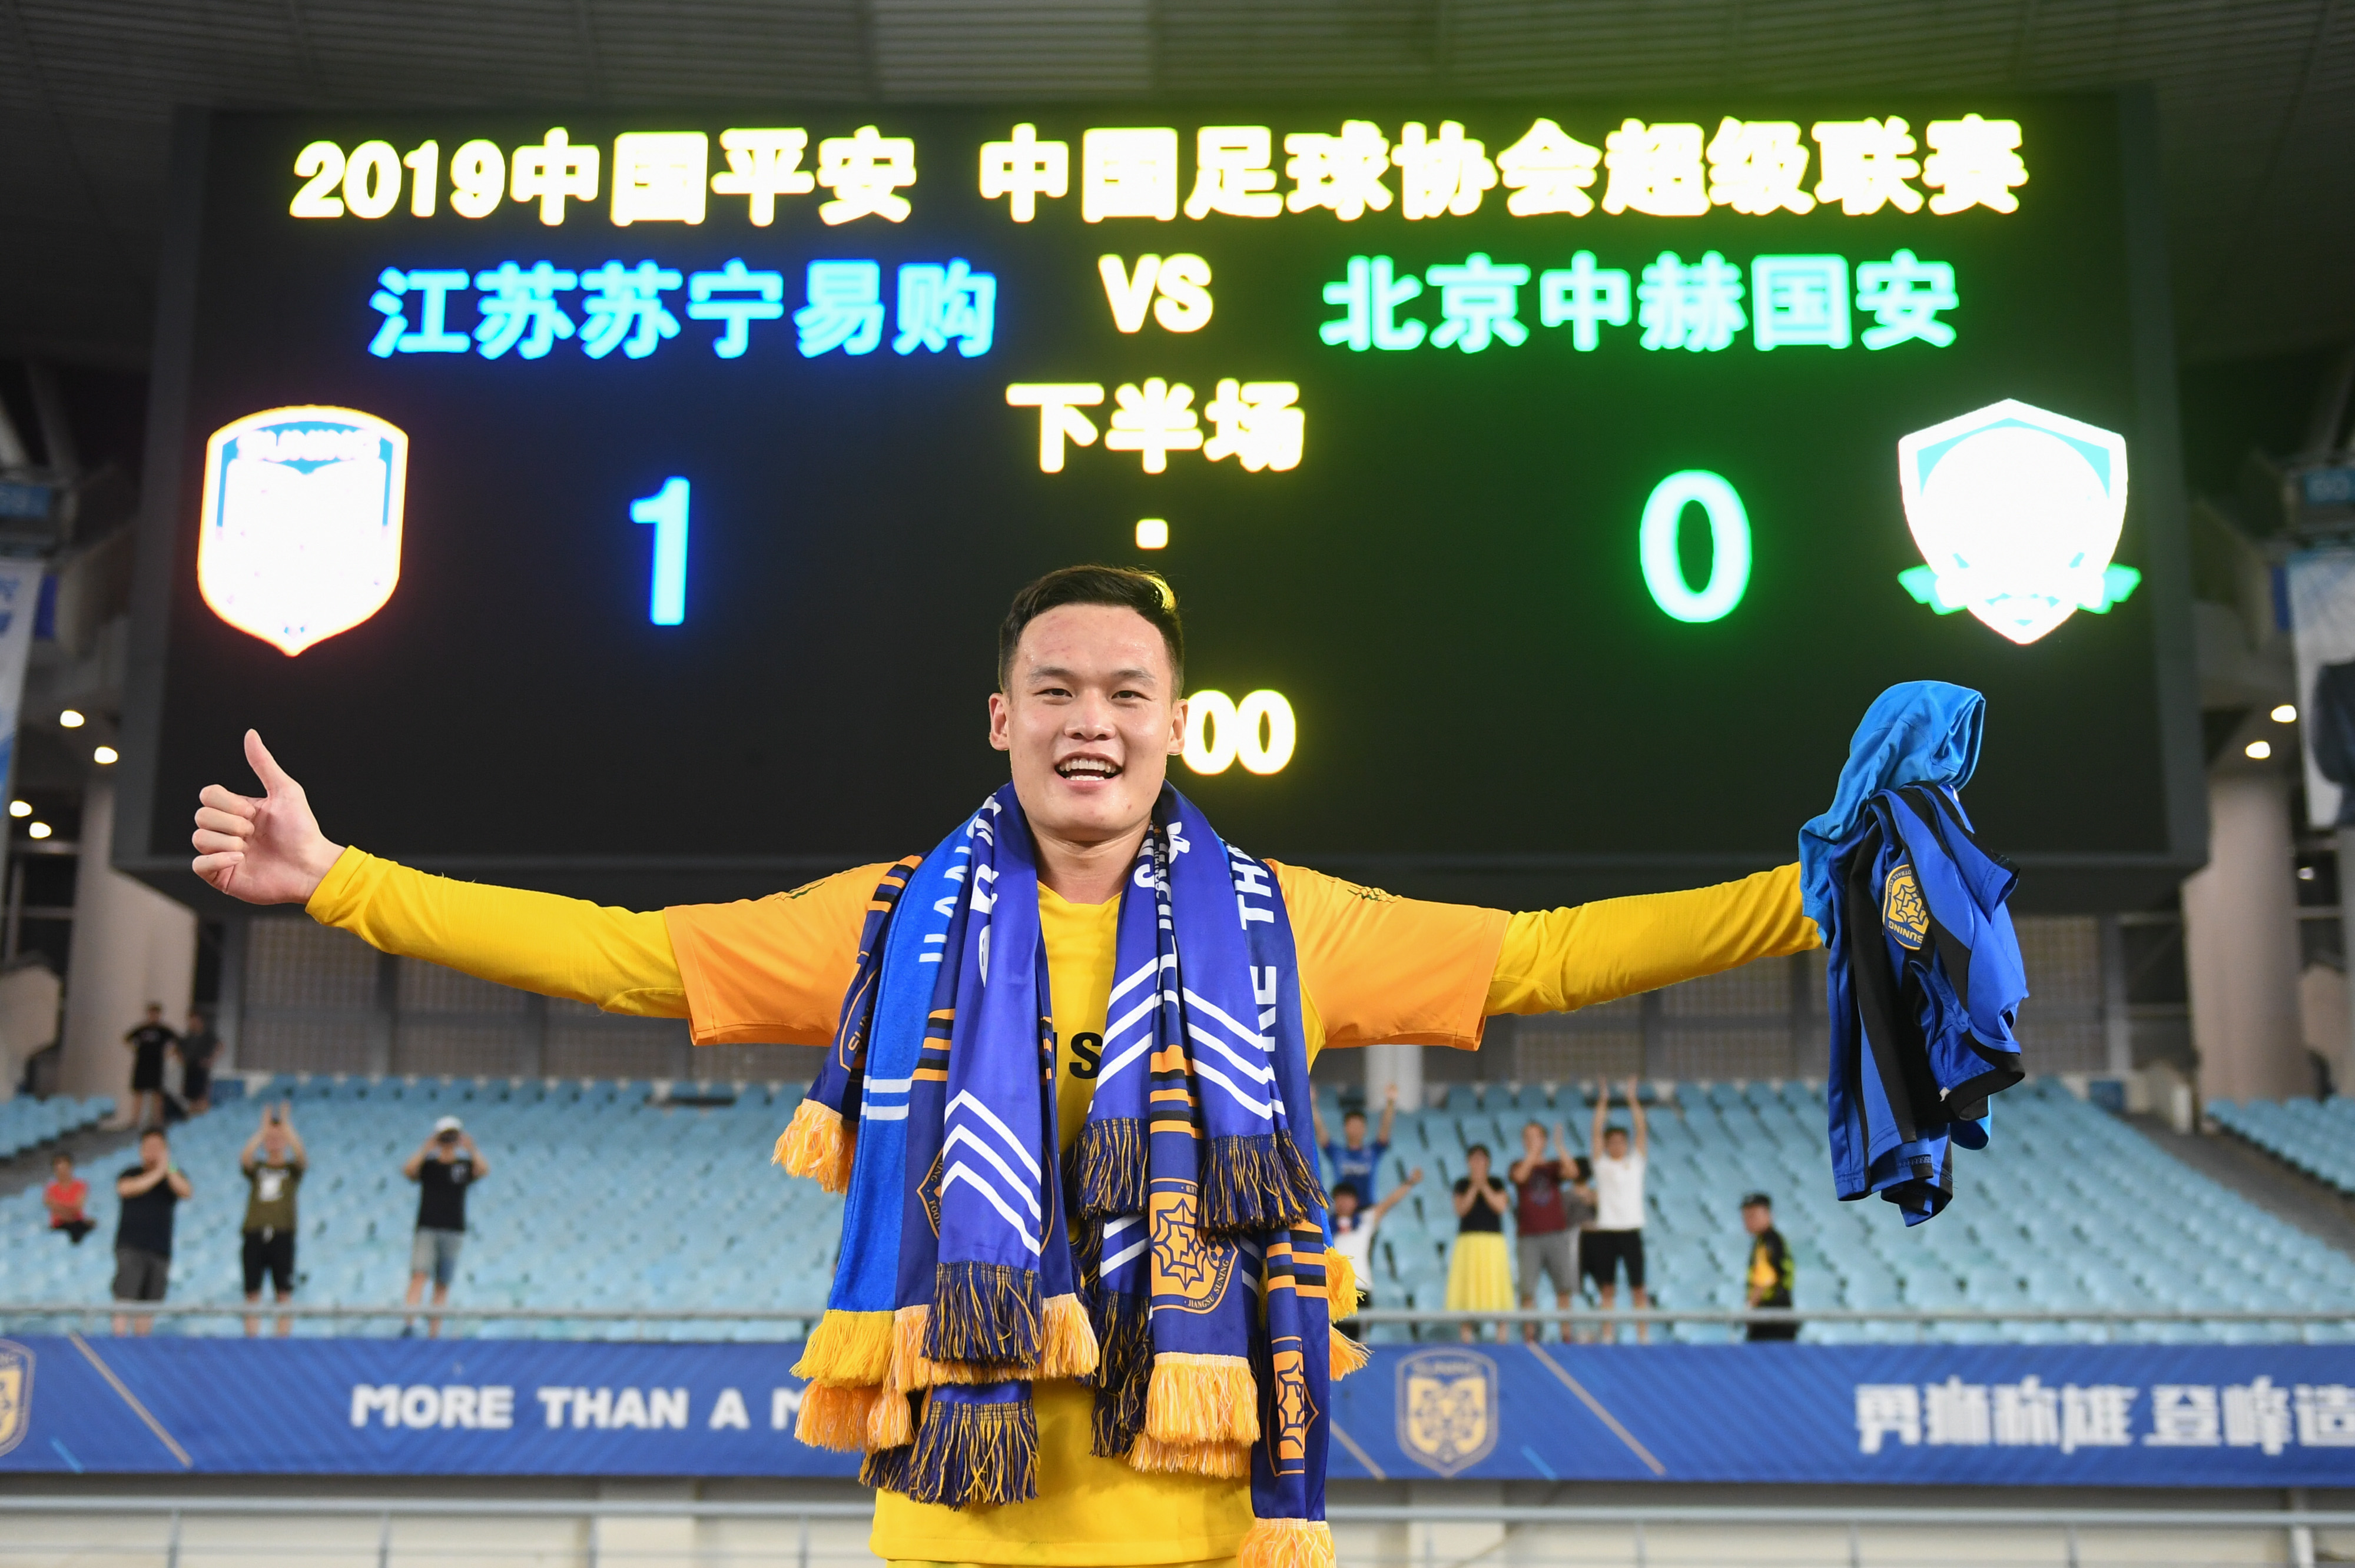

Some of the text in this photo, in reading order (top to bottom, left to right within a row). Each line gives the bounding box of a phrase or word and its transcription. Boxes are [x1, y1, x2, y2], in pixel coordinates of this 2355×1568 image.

[290, 114, 2029, 227] 2019中国平安 中国足球协会超级联赛
[368, 257, 996, 360] 江苏苏宁易购
[1098, 254, 1213, 333] VS
[1319, 248, 1959, 354] 北京中赫国安
[1006, 377, 1305, 474] 下半场
[629, 476, 689, 625] 1
[1639, 470, 1752, 623] 0
[1888, 920, 1924, 944] SUNING
[1188, 1259, 1229, 1308] JIANGSU SUNING
[350, 1386, 514, 1429] MORE
[537, 1387, 689, 1429] THAN
[709, 1388, 749, 1429] A
